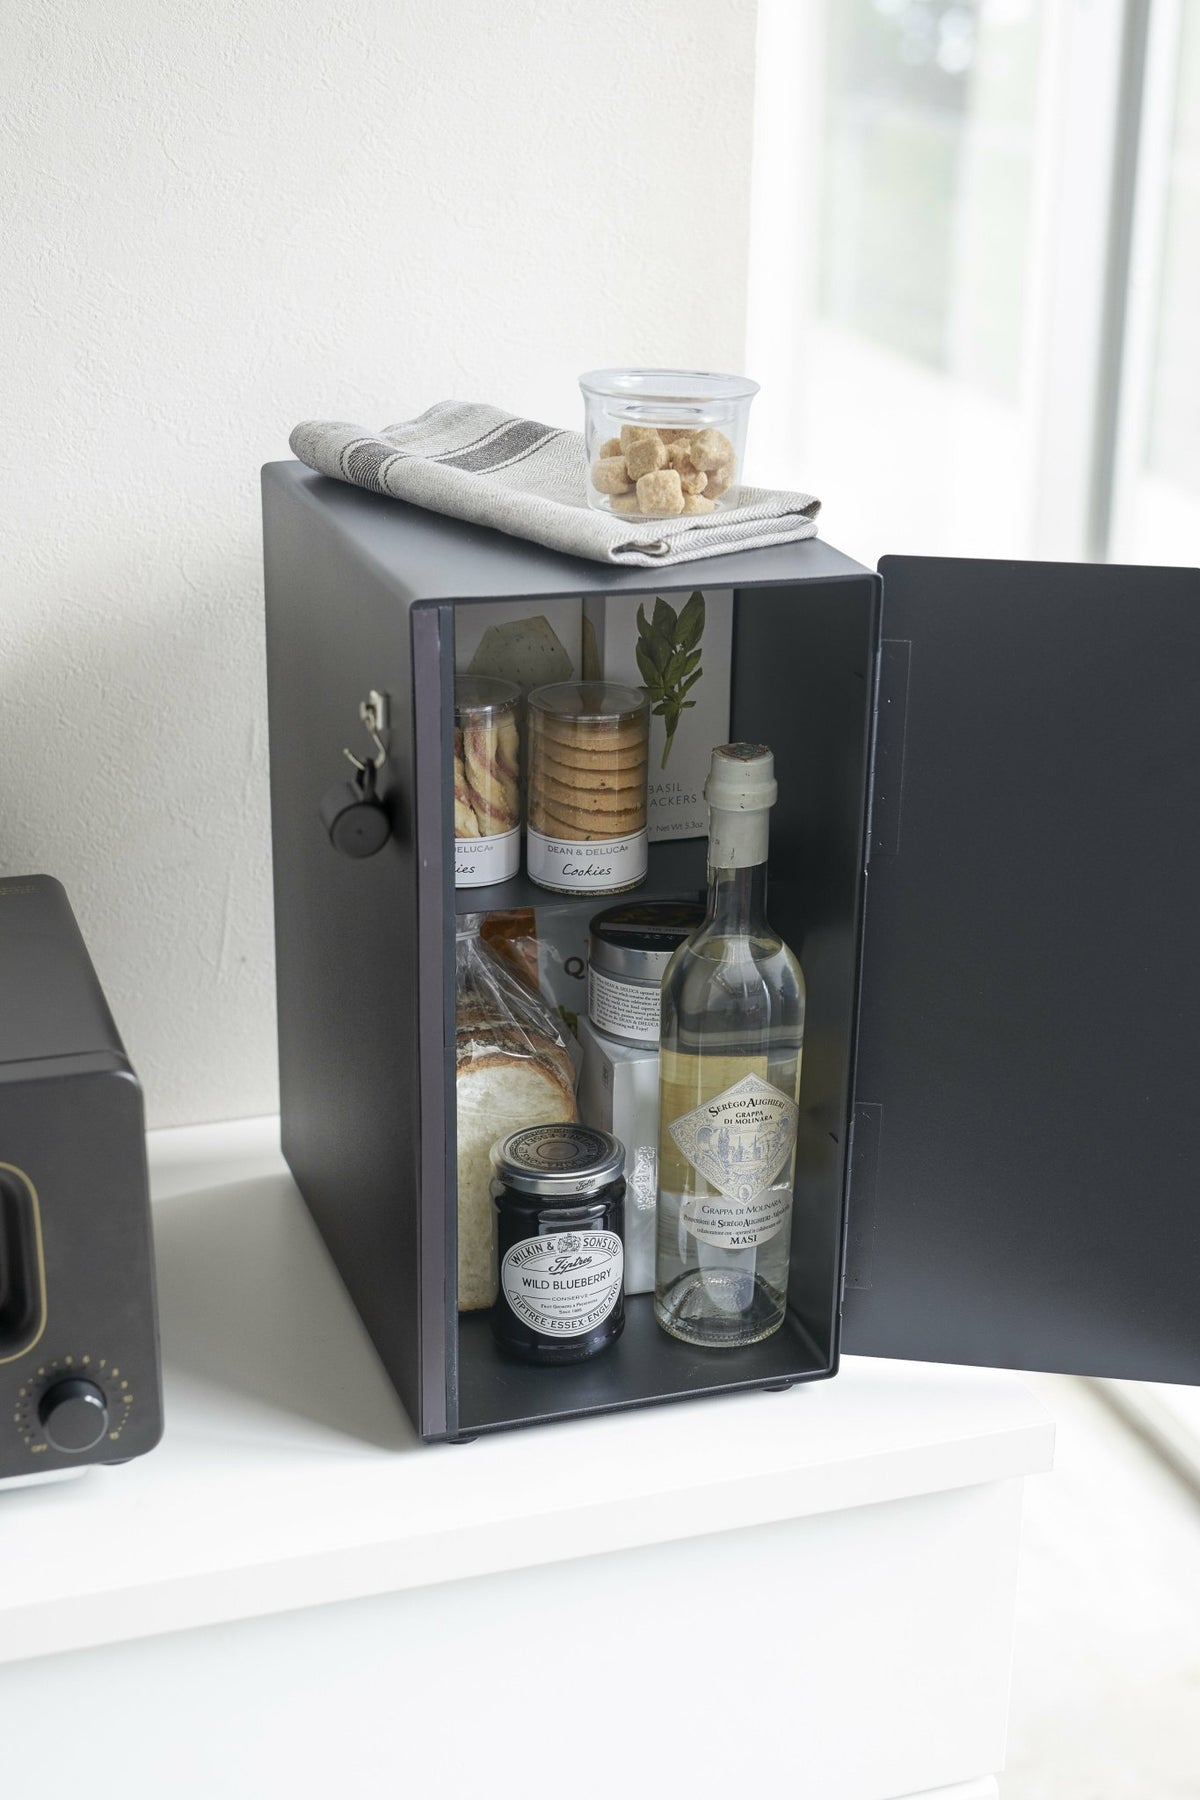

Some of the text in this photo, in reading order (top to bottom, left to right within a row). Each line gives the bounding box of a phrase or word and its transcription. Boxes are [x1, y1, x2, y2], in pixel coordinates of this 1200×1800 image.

[650, 794, 697, 807] ACKERS
[456, 845, 491, 853] ELUCA
[547, 845, 573, 856] DEAN
[562, 863, 612, 876] Cookies
[735, 1110, 764, 1118] GRAPPA
[735, 1114, 773, 1125] MOLINARA
[702, 1205, 733, 1215] GRAPPA
[746, 1199, 782, 1214] MOLINARA
[730, 1234, 758, 1245] MASI
[511, 1243, 544, 1265] WILKIN
[546, 1241, 554, 1251] &
[583, 1237, 606, 1248] SONS
[548, 1255, 593, 1275] Tiptree
[522, 1267, 612, 1290] WILD BLUEBERRY
[551, 1294, 588, 1302] CONSERVE
[513, 1295, 548, 1326] TIPTREE
[550, 1319, 585, 1329] ESSEX
